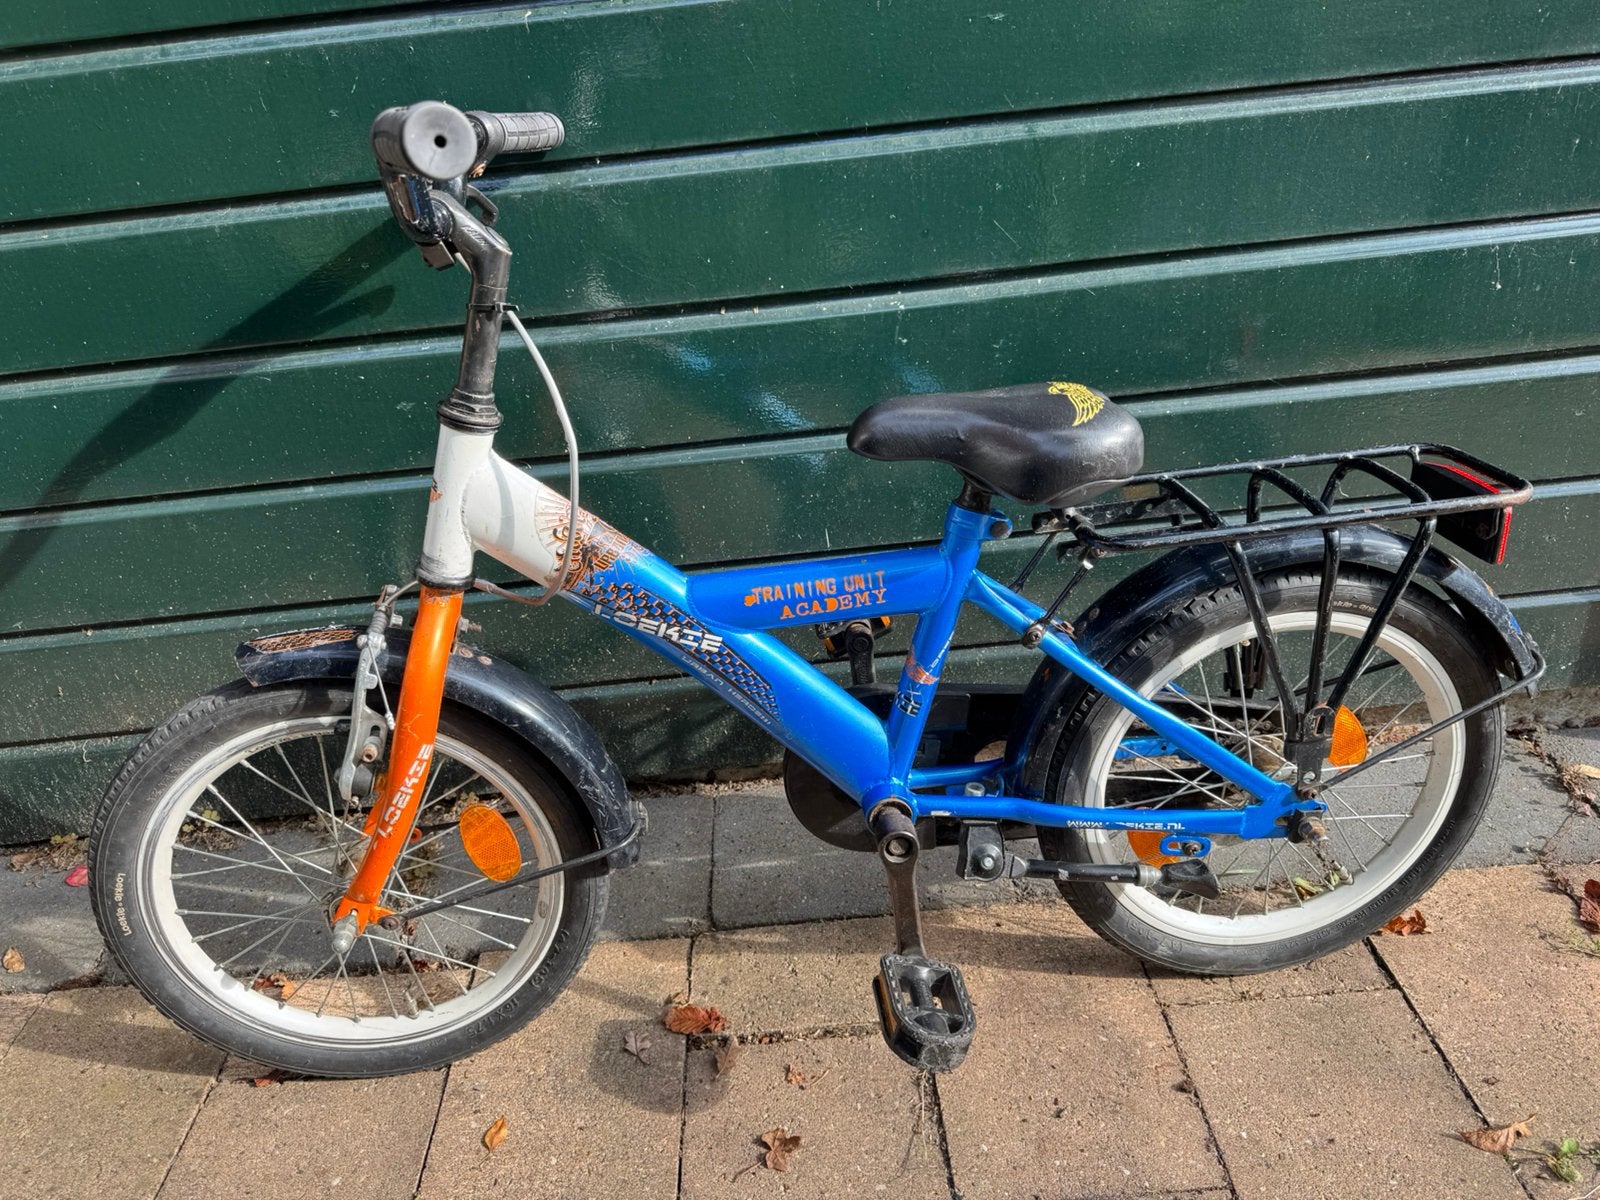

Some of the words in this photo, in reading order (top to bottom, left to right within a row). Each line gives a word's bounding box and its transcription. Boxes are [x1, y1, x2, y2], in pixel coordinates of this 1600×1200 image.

[752, 577, 837, 605] TRAINING
[843, 570, 886, 593] UNIT
[780, 588, 887, 619] ACADEMY
[114, 872, 126, 902] Loekie
[116, 907, 133, 936] Loekie
